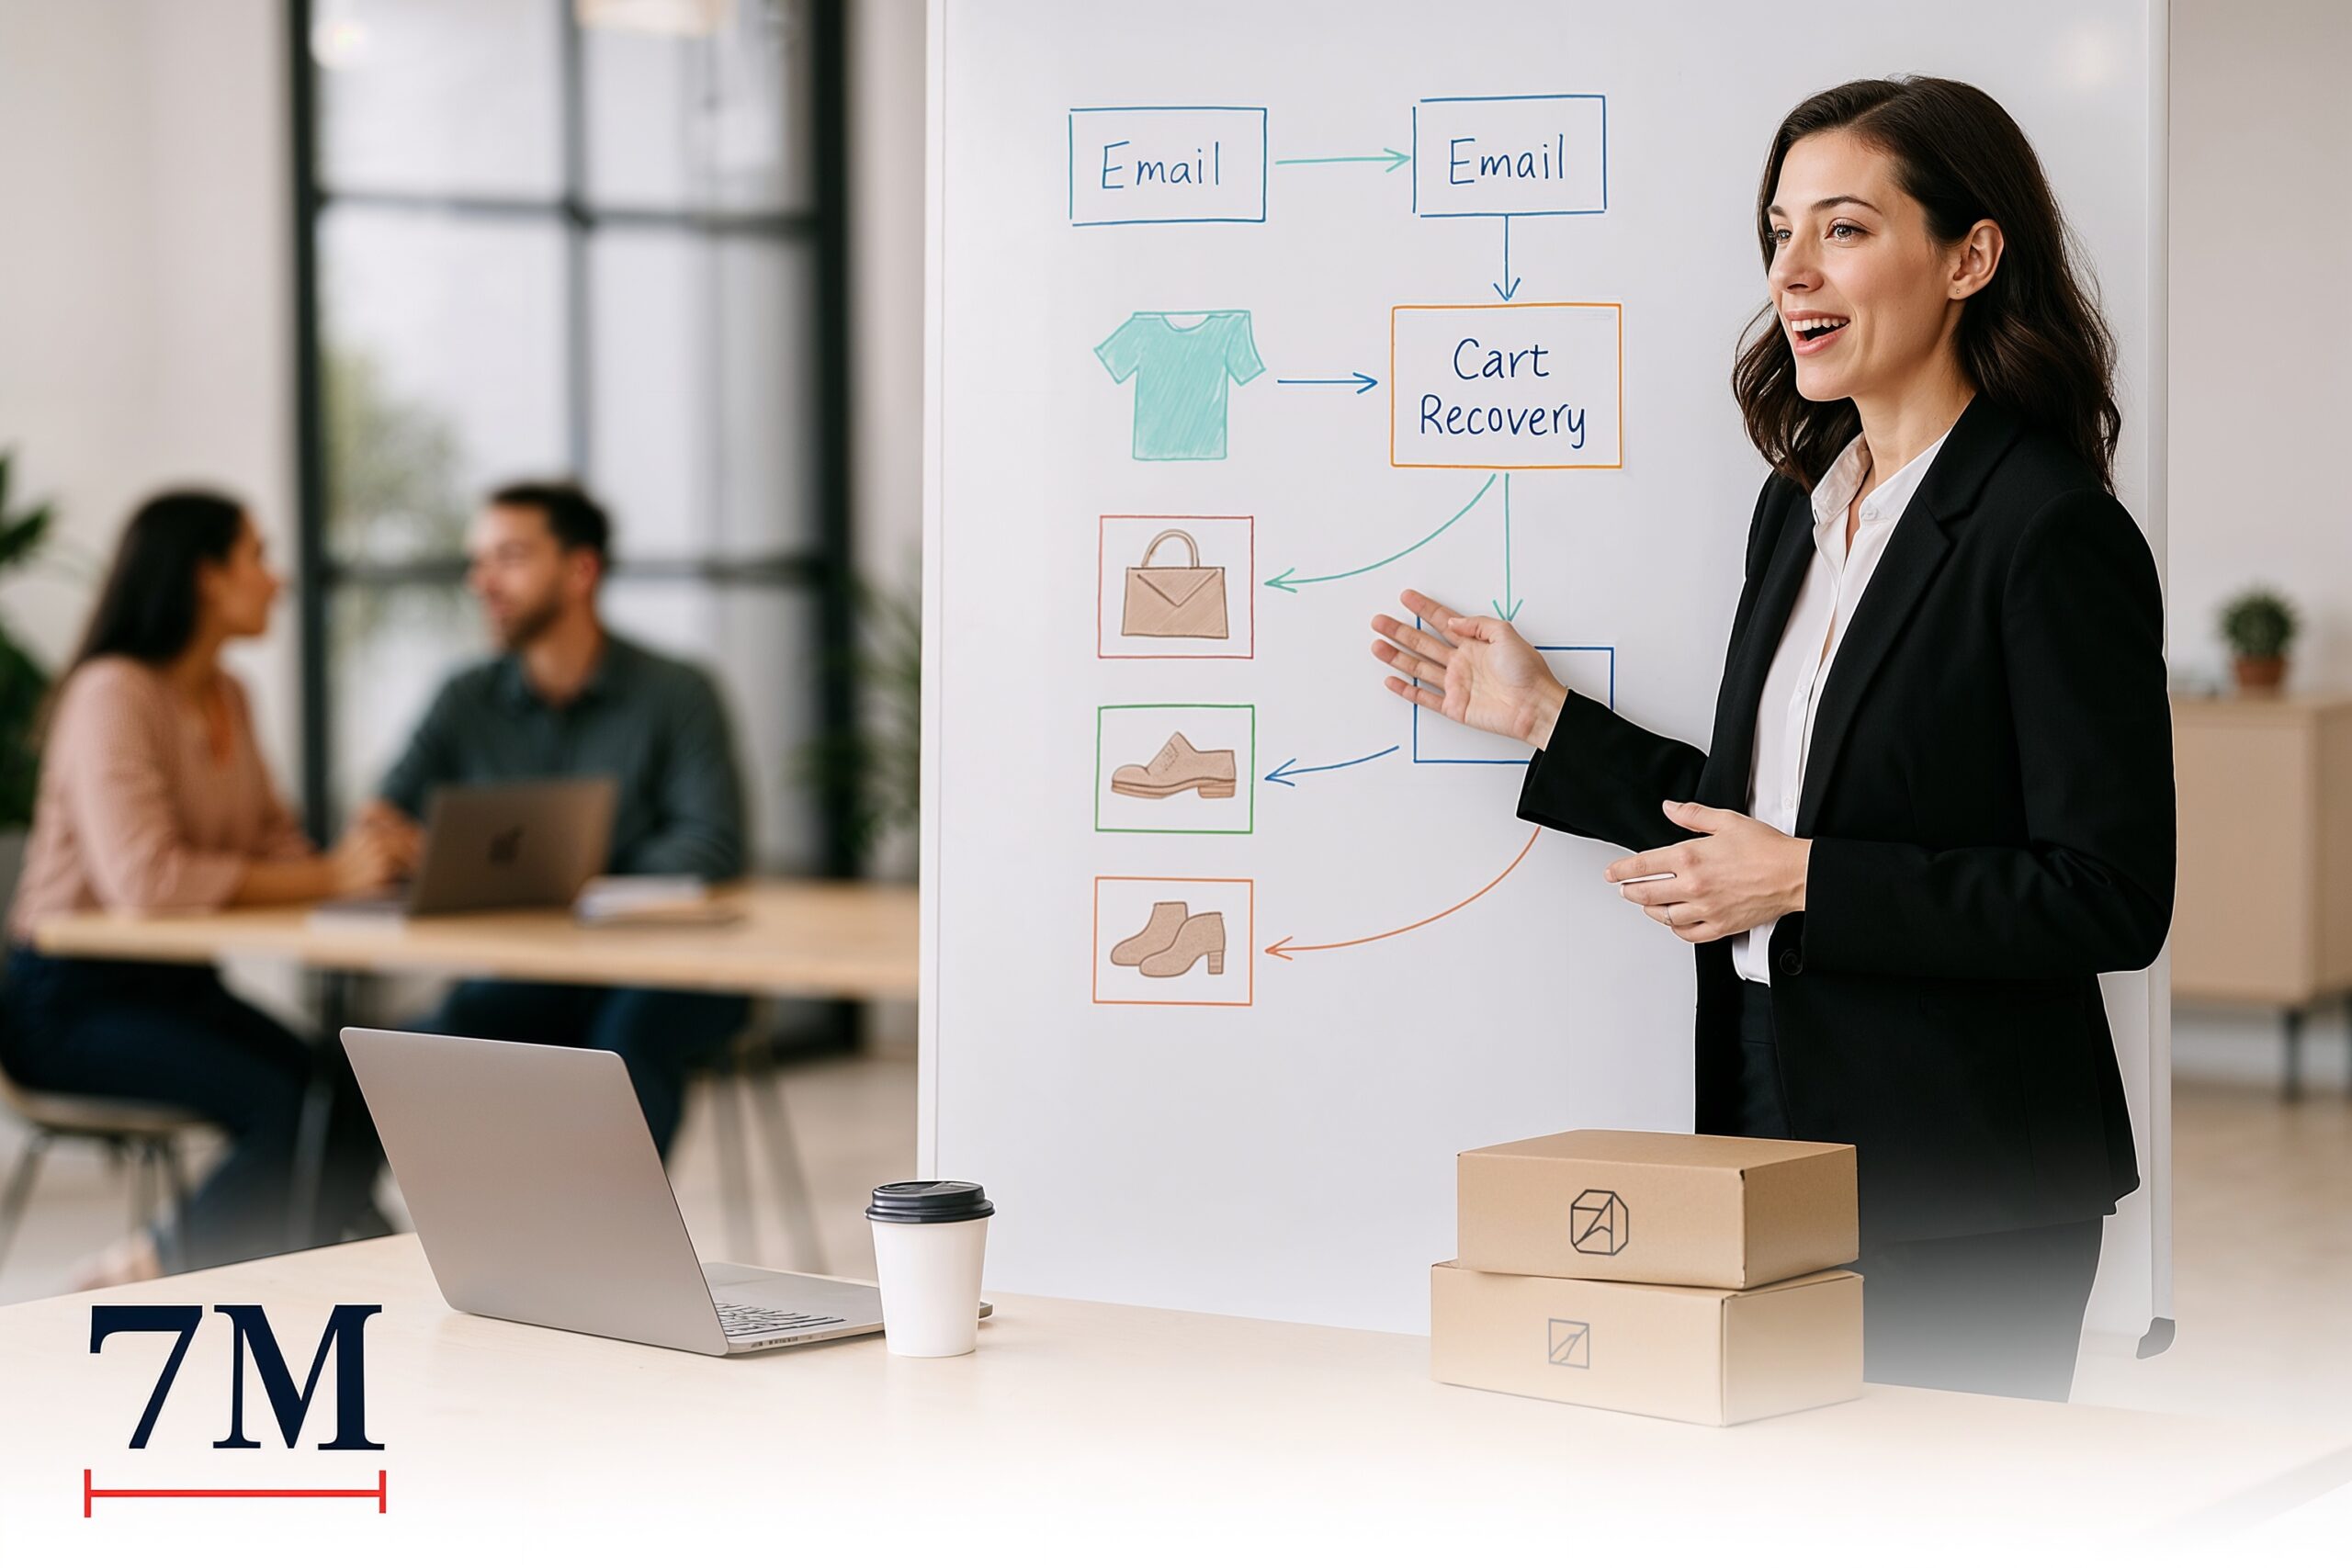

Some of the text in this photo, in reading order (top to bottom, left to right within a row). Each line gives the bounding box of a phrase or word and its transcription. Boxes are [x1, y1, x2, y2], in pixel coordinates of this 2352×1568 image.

[1101, 141, 1219, 189] Email
[1450, 133, 1564, 185] Email
[1453, 338, 1550, 380] Cart
[1419, 394, 1587, 448] Recovery
